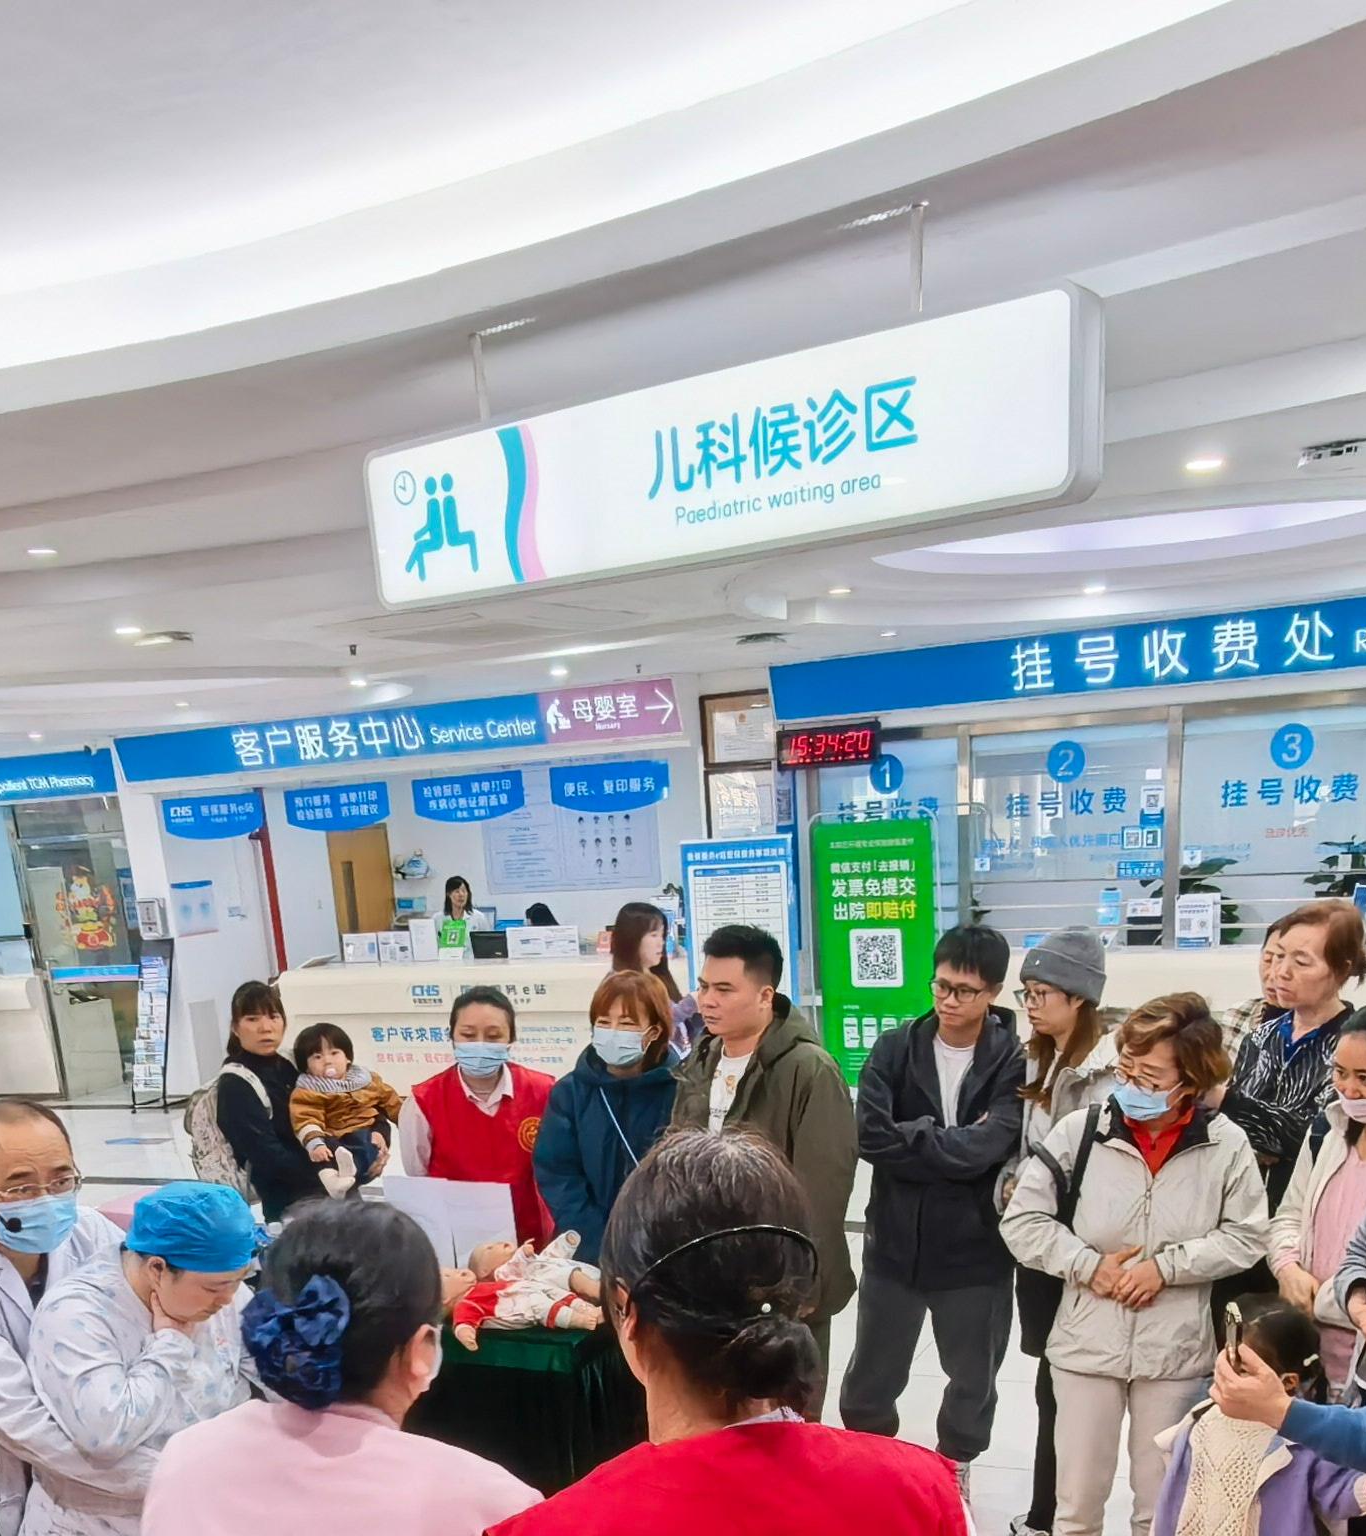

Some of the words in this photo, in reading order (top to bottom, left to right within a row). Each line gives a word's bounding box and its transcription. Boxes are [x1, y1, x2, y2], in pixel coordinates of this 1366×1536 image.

[647, 375, 919, 501] 儿科候诊区
[674, 493, 763, 527] Paediatric
[767, 480, 835, 511] waiting
[840, 472, 882, 495] area
[1010, 609, 1335, 692] 挂号收费处
[572, 693, 640, 723] 母婴室
[230, 713, 424, 768] 客户服务中心
[430, 724, 484, 745] Service
[486, 718, 538, 740] Center
[789, 730, 872, 757] 15:34:20
[1057, 748, 1077, 778] 2
[1281, 733, 1302, 763] 3
[50, 775, 95, 789] Pharmacy
[1221, 774, 1360, 809] 挂号收费
[1005, 786, 1128, 819] 挂号收费
[831, 876, 917, 898] 发票免提交
[833, 899, 917, 921] 出院即赔付
